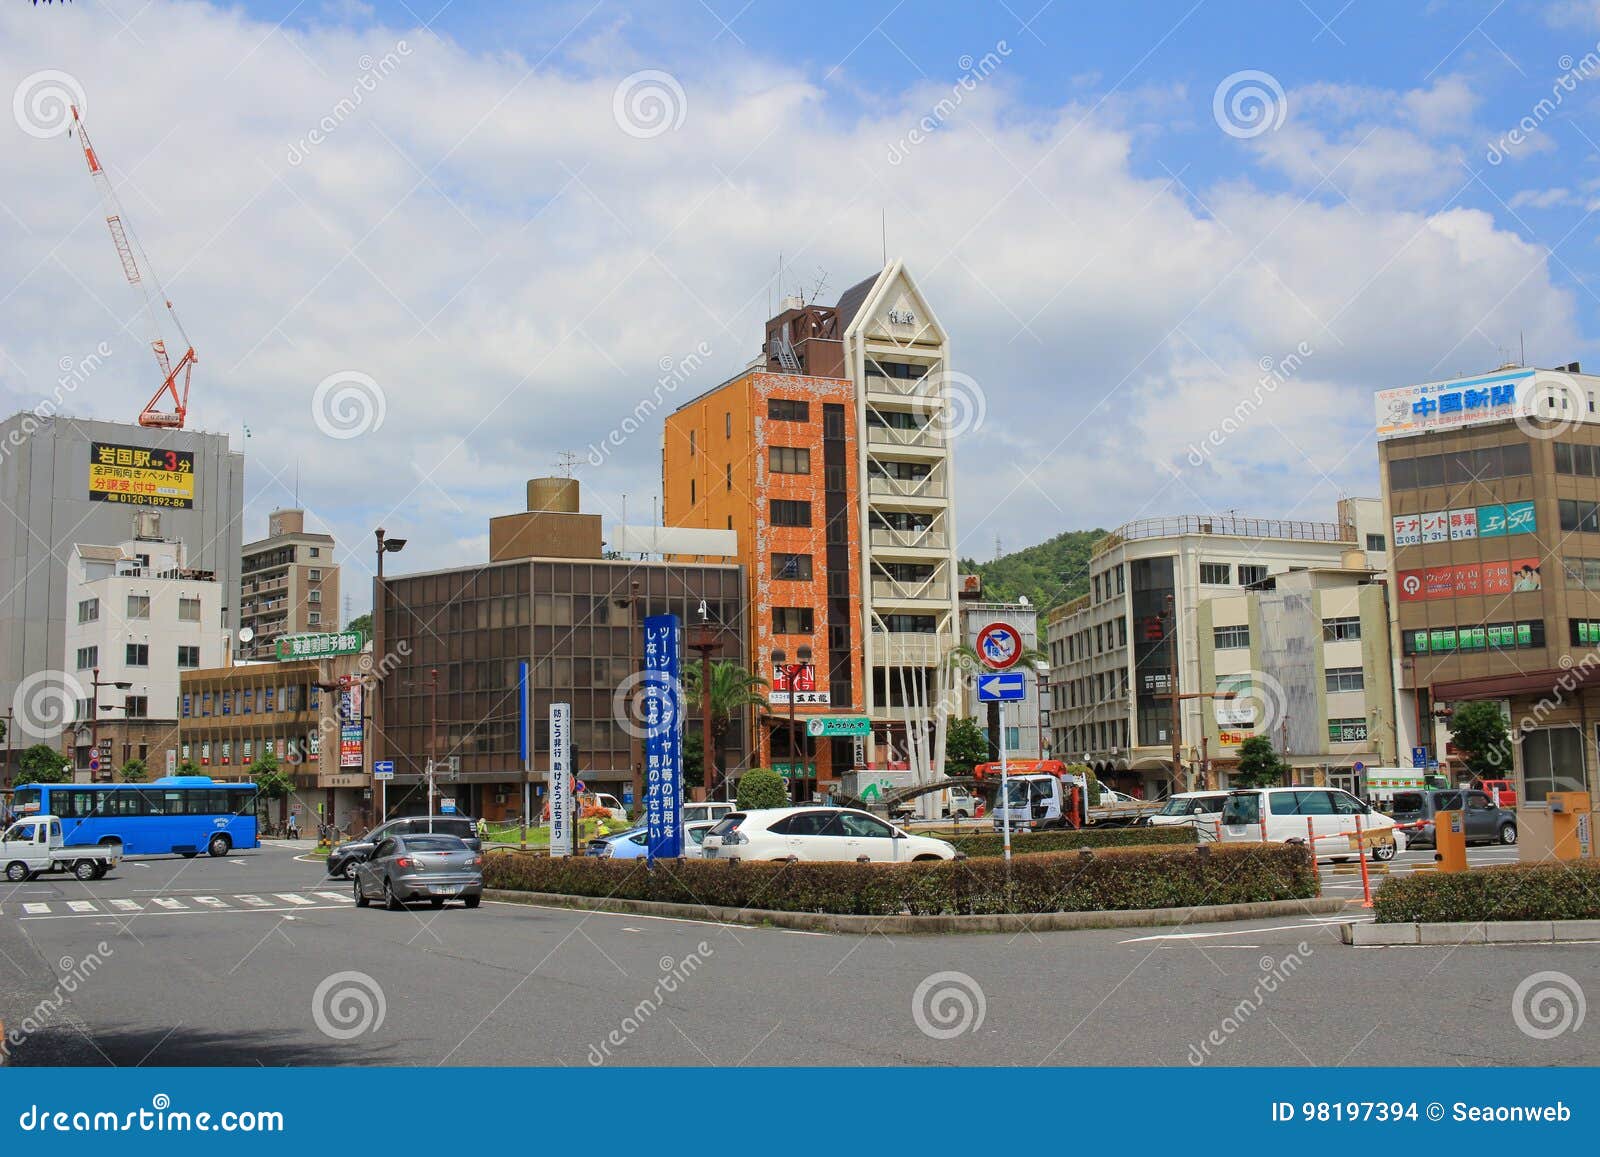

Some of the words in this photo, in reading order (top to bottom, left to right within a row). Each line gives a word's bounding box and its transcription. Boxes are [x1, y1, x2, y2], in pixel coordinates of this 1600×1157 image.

[120, 494, 185, 507] 0120-1892-86
[1395, 513, 1475, 533] テナント募集
[660, 626, 675, 838] ツーショットダイヤル等の利用を
[1343, 728, 1367, 740] 整体
[553, 762, 562, 839] 助けよう立ち直り
